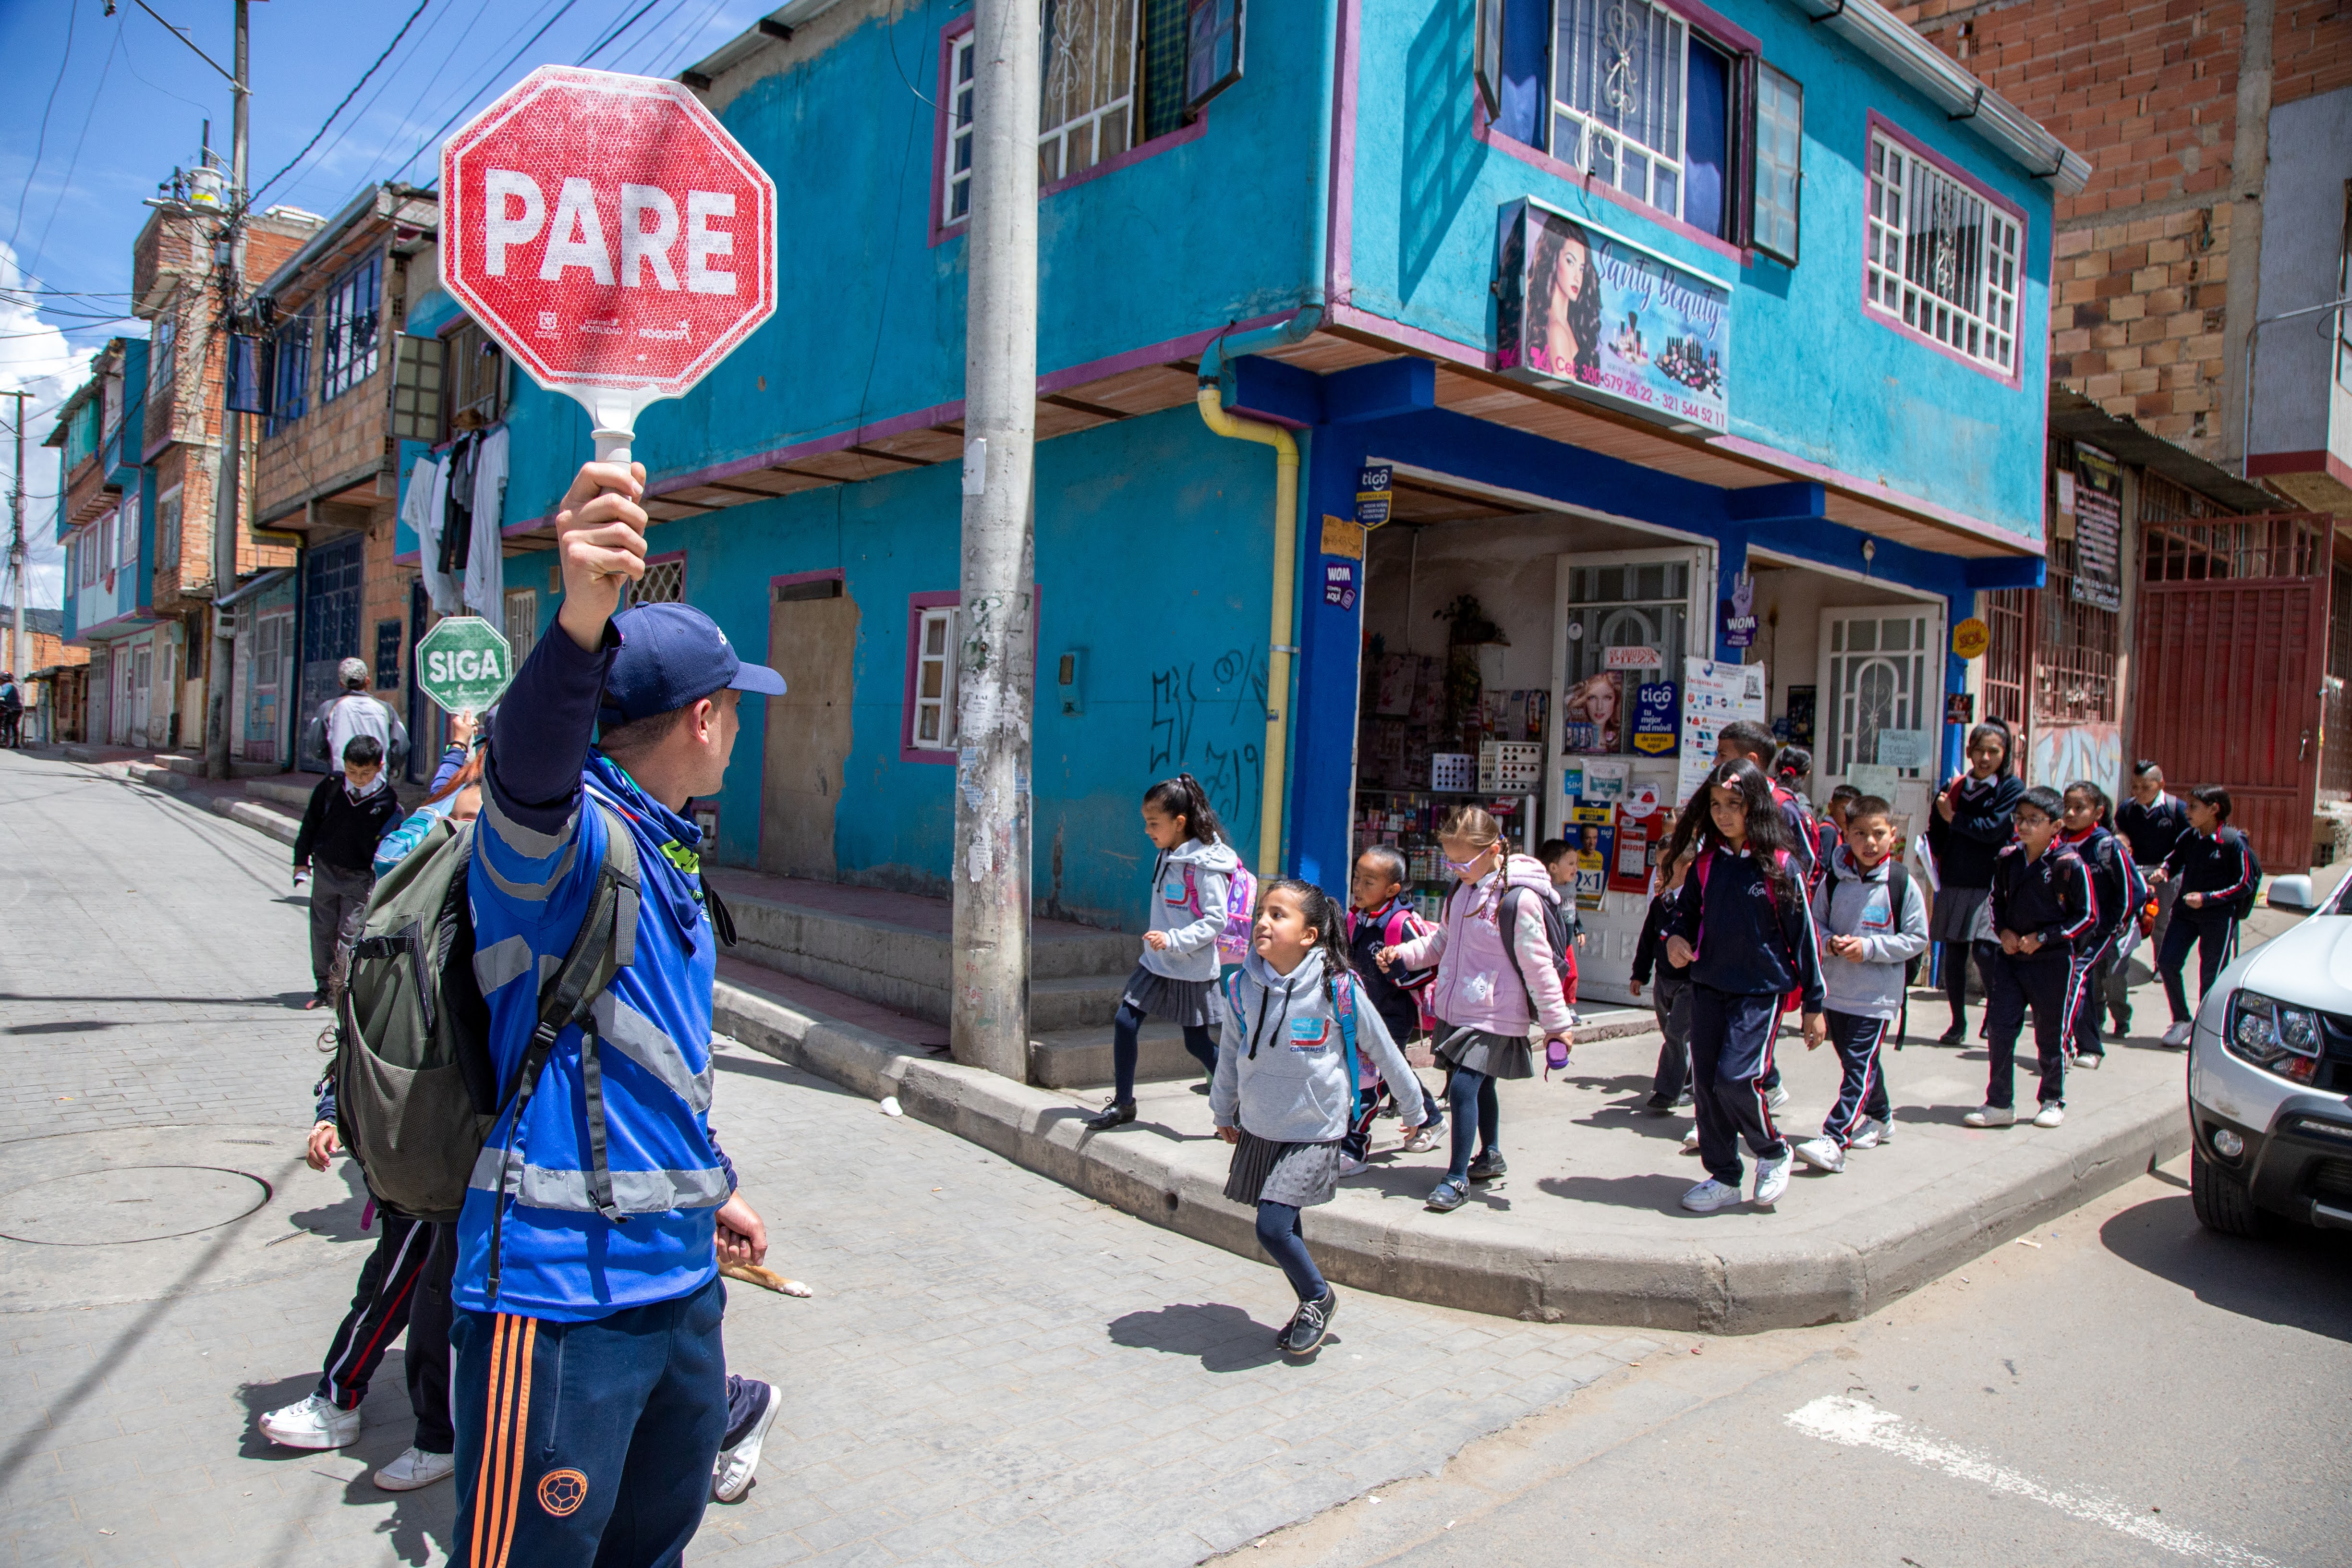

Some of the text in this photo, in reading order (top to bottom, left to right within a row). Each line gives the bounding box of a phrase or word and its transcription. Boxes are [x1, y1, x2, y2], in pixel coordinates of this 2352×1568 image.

[485, 168, 737, 296] PARE
[1599, 242, 1722, 340] Santy Beauty
[579, 325, 623, 335] MOVILIDAD
[1555, 355, 1578, 377] Cel:
[1581, 363, 1601, 384] 300
[1604, 372, 1623, 391] 579
[1625, 379, 1638, 397] 26
[1640, 386, 1652, 402] 22
[1662, 393, 1678, 412] 321
[1682, 400, 1698, 418] 544
[1701, 407, 1712, 423] 52
[1716, 412, 1724, 427] 11
[1327, 567, 1351, 582] WOM
[1727, 616, 1756, 631] WOM
[1959, 630, 1986, 649] SOL
[428, 649, 502, 683] SIGA
[1639, 723, 1672, 732] red móvil
[1641, 715, 1662, 724] mejor
